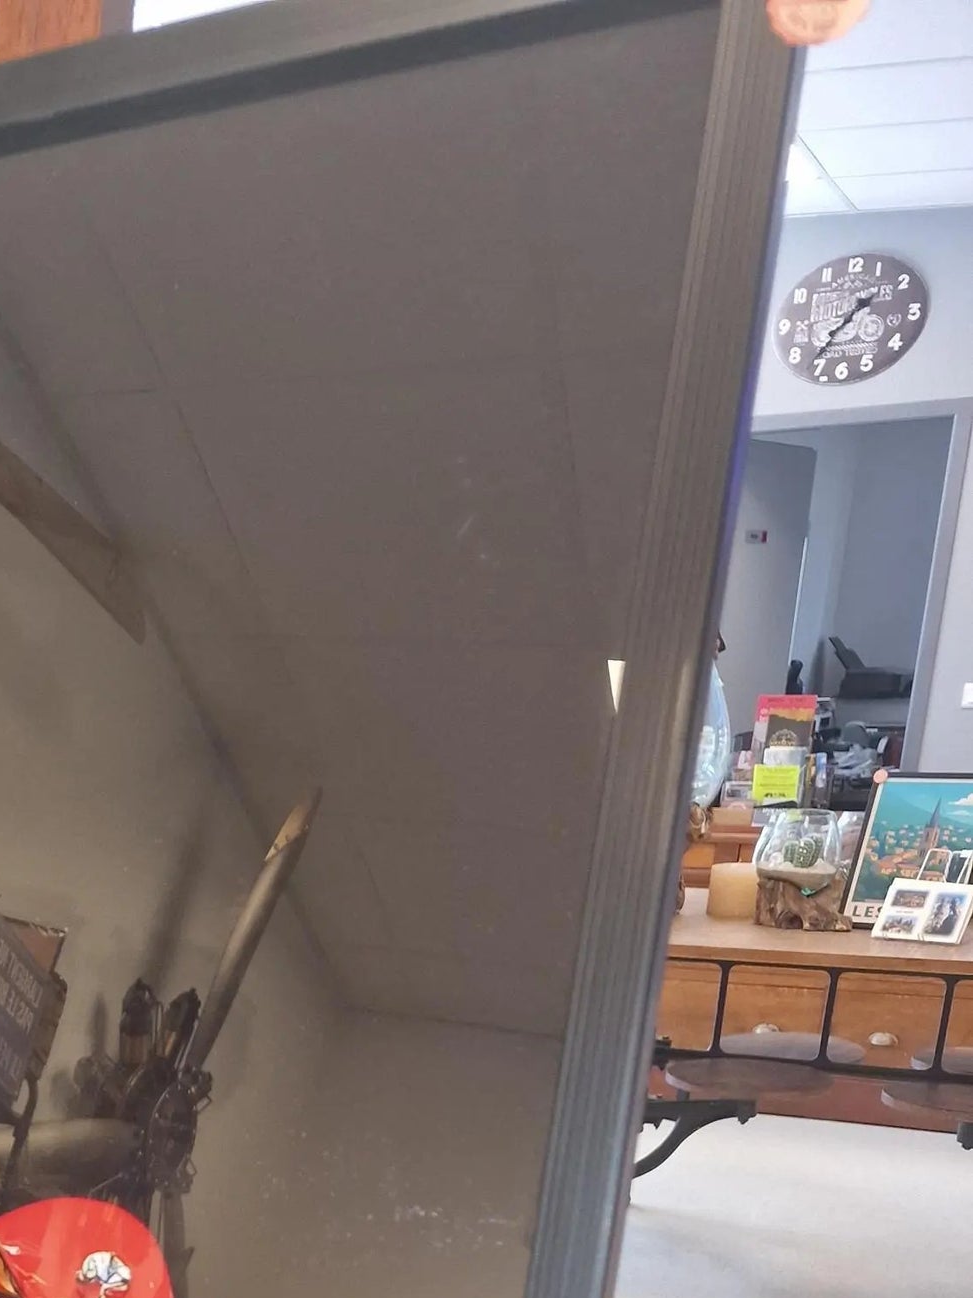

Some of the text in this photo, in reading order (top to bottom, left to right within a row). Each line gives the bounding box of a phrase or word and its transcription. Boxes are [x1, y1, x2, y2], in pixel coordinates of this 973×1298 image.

[848, 257, 864, 273] 12
[875, 261, 882, 277] 1
[821, 267, 832, 282] 11
[897, 274, 910, 290] 2
[793, 288, 807, 304] 10
[907, 303, 921, 320] 3
[778, 319, 791, 335] 9
[887, 332, 903, 351] 4
[788, 346, 802, 364] 8
[859, 354, 874, 372] 5
[813, 358, 826, 376] 7
[834, 361, 848, 380] 6
